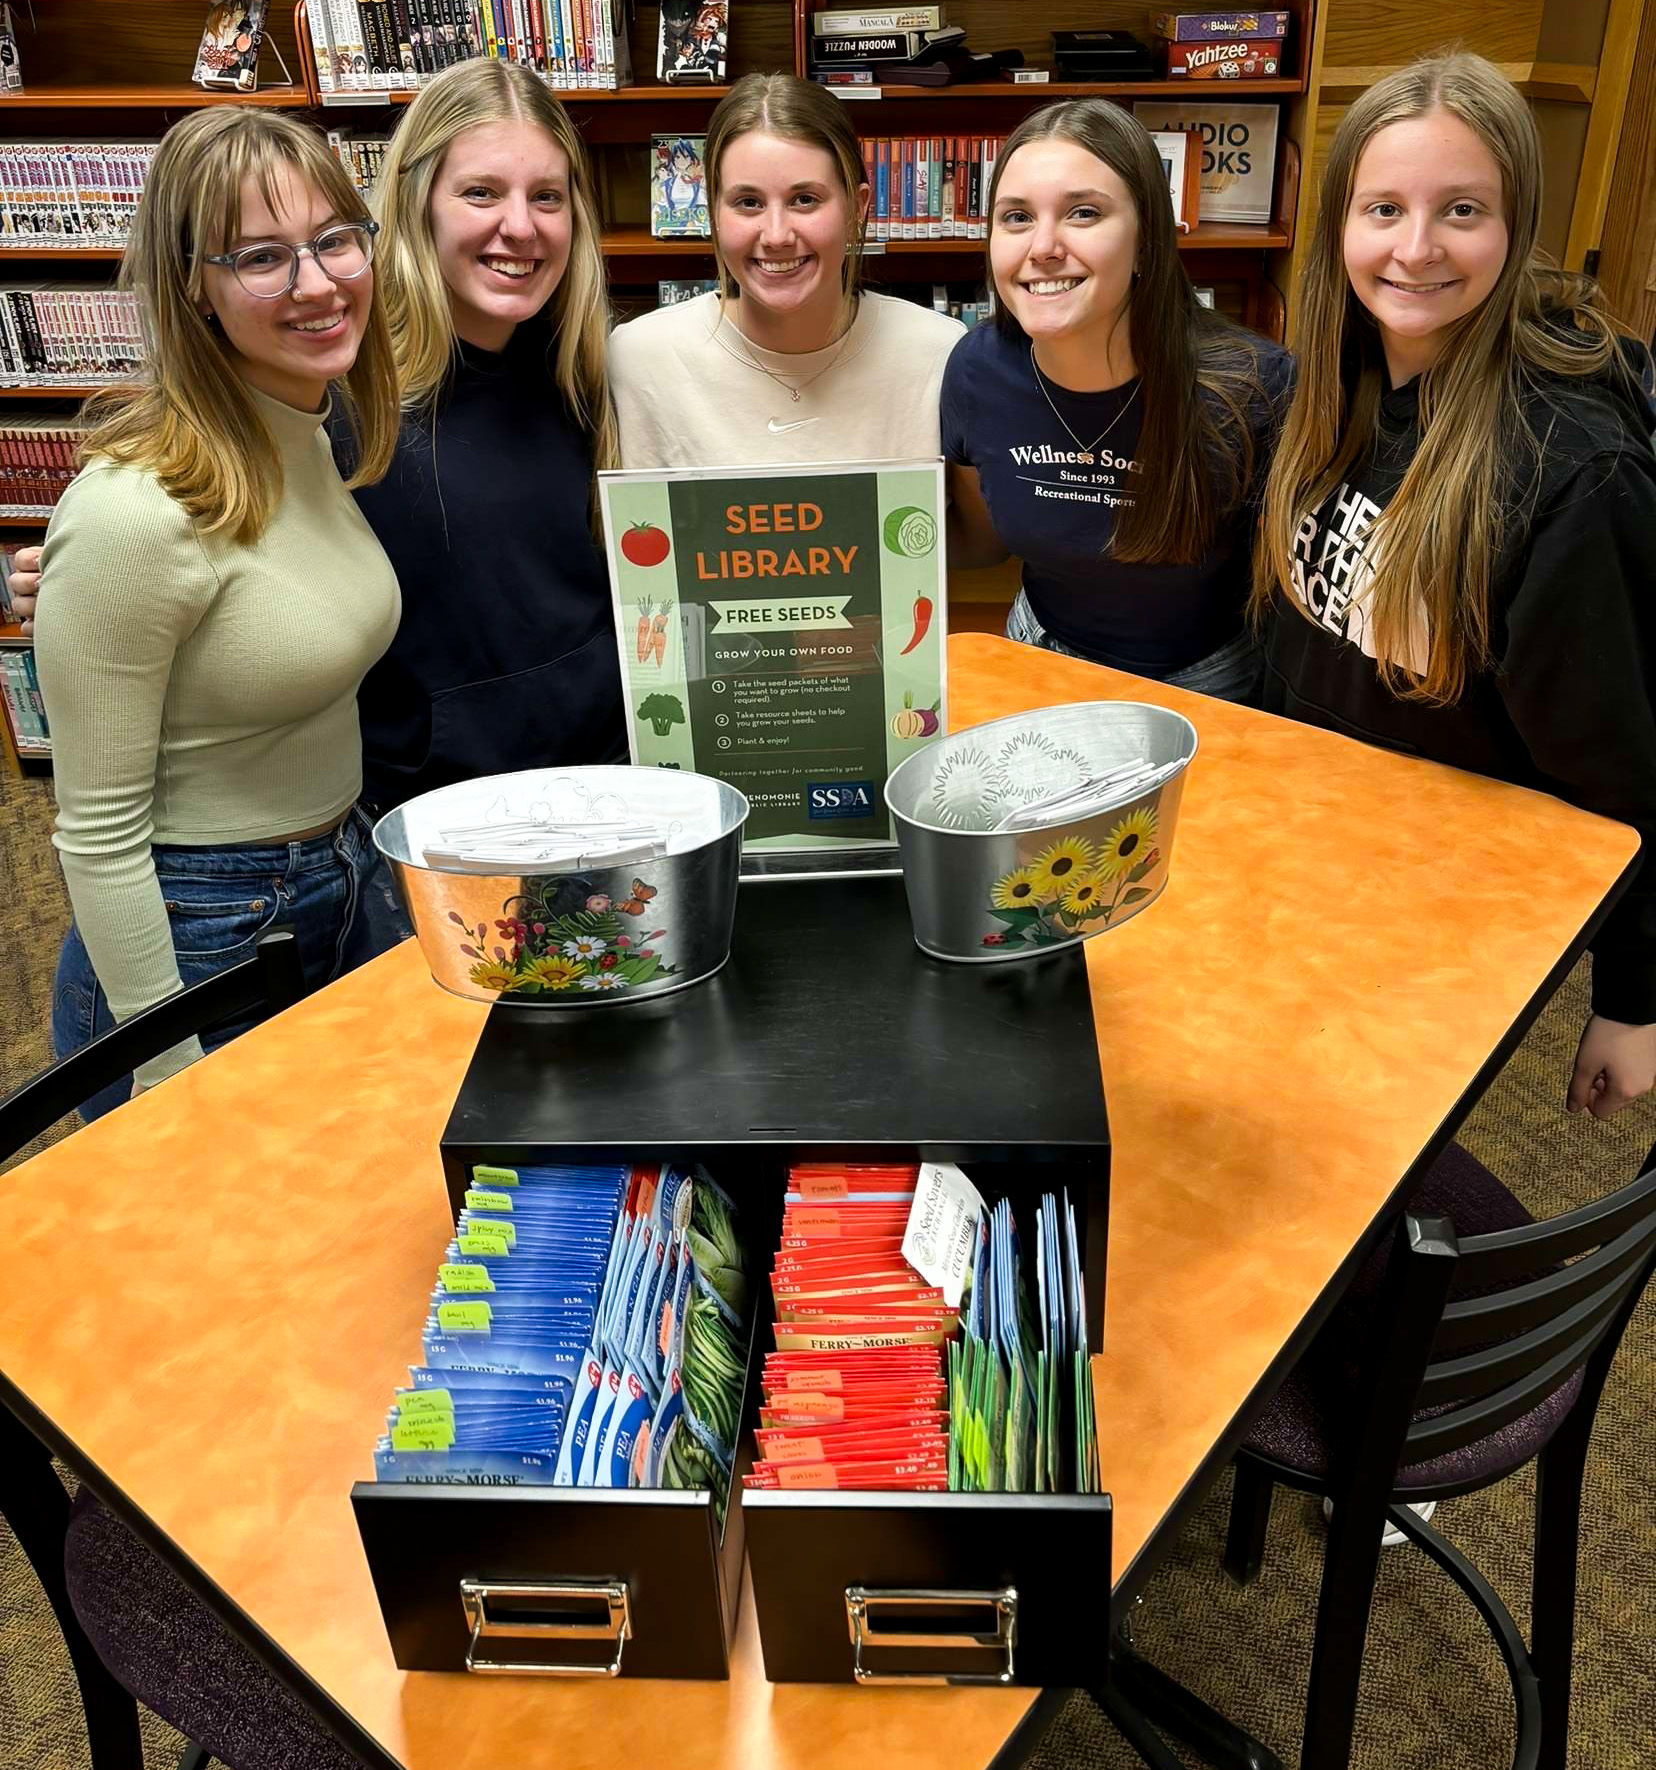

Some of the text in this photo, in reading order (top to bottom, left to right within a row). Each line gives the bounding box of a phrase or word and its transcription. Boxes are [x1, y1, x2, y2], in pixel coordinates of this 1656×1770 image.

[825, 39, 896, 52] WOODEN PUZZLE
[1185, 43, 1248, 69] Yahtzee
[1009, 444, 1094, 466] Wellness
[1060, 470, 1115, 484] Since 1993
[1035, 486, 1101, 503] Recreational
[726, 503, 823, 534] SEED
[697, 546, 858, 579] LIBRARY
[726, 606, 836, 623] FREE SEEDS
[715, 646, 854, 660] GROW YOUR OWN FOOD
[733, 680, 752, 688] Take
[753, 680, 766, 688] the
[768, 679, 788, 687] seed
[788, 678, 818, 689] packets
[820, 677, 828, 685] of
[830, 676, 849, 684] what
[733, 690, 748, 698] you
[749, 688, 768, 696] want
[780, 688, 799, 696] grow
[800, 686, 814, 694] (no
[792, 709, 817, 717] sheets
[818, 708, 826, 716] to
[828, 708, 846, 717] help
[736, 720, 752, 728] you
[752, 720, 770, 728] grow
[766, 736, 790, 746] enjoy!
[720, 770, 757, 778] Partnering
[760, 768, 790, 777] together
[792, 768, 802, 776] for
[804, 766, 843, 774] community
[812, 787, 869, 808] SSDA
[920, 1168, 944, 1234] Seed Savers
[786, 1240, 801, 1248] 4.25
[952, 1215, 975, 1278] CUCUMBER
[555, 1354, 574, 1362] $1.96
[575, 1418, 588, 1449] PEA
[616, 1430, 630, 1459] PEA
